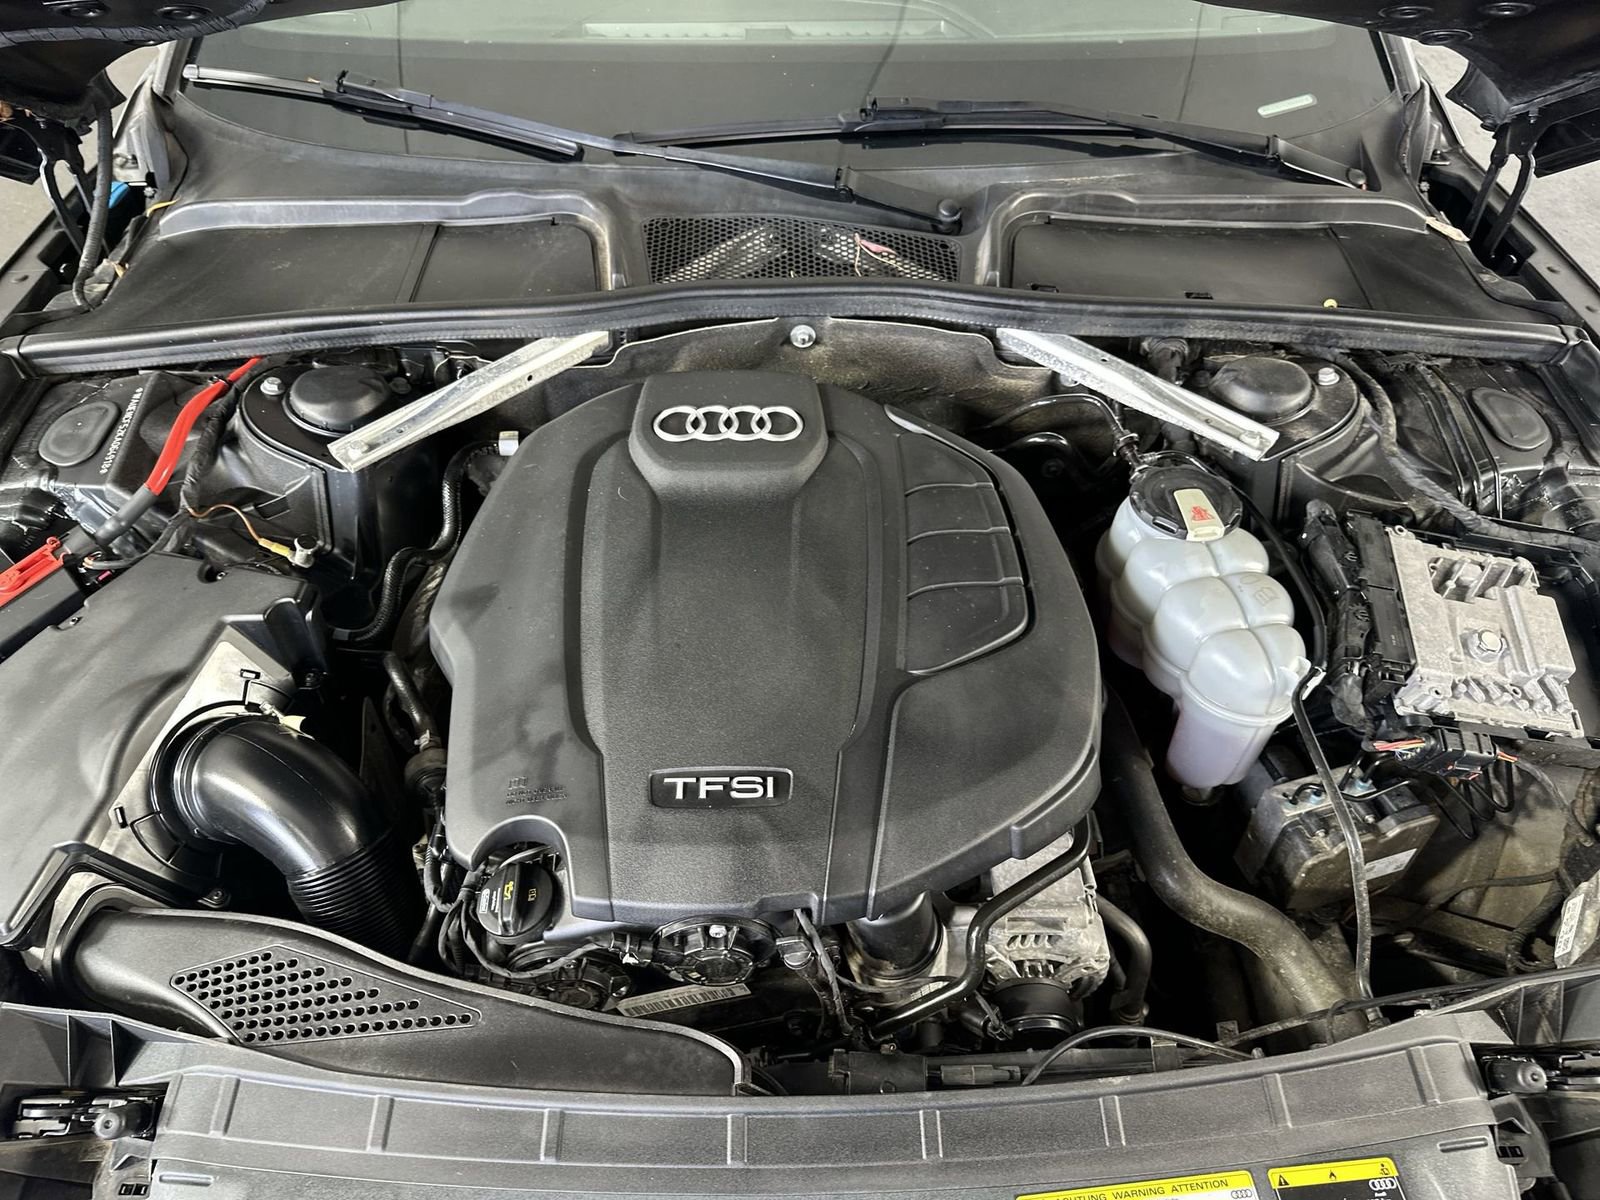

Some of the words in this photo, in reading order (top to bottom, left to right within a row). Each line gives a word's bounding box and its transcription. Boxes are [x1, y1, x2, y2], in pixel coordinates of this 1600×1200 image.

[664, 776, 774, 799] TFSI
[1112, 1187, 1165, 1199] WARNING
[1172, 1179, 1229, 1194] ATTENTION
